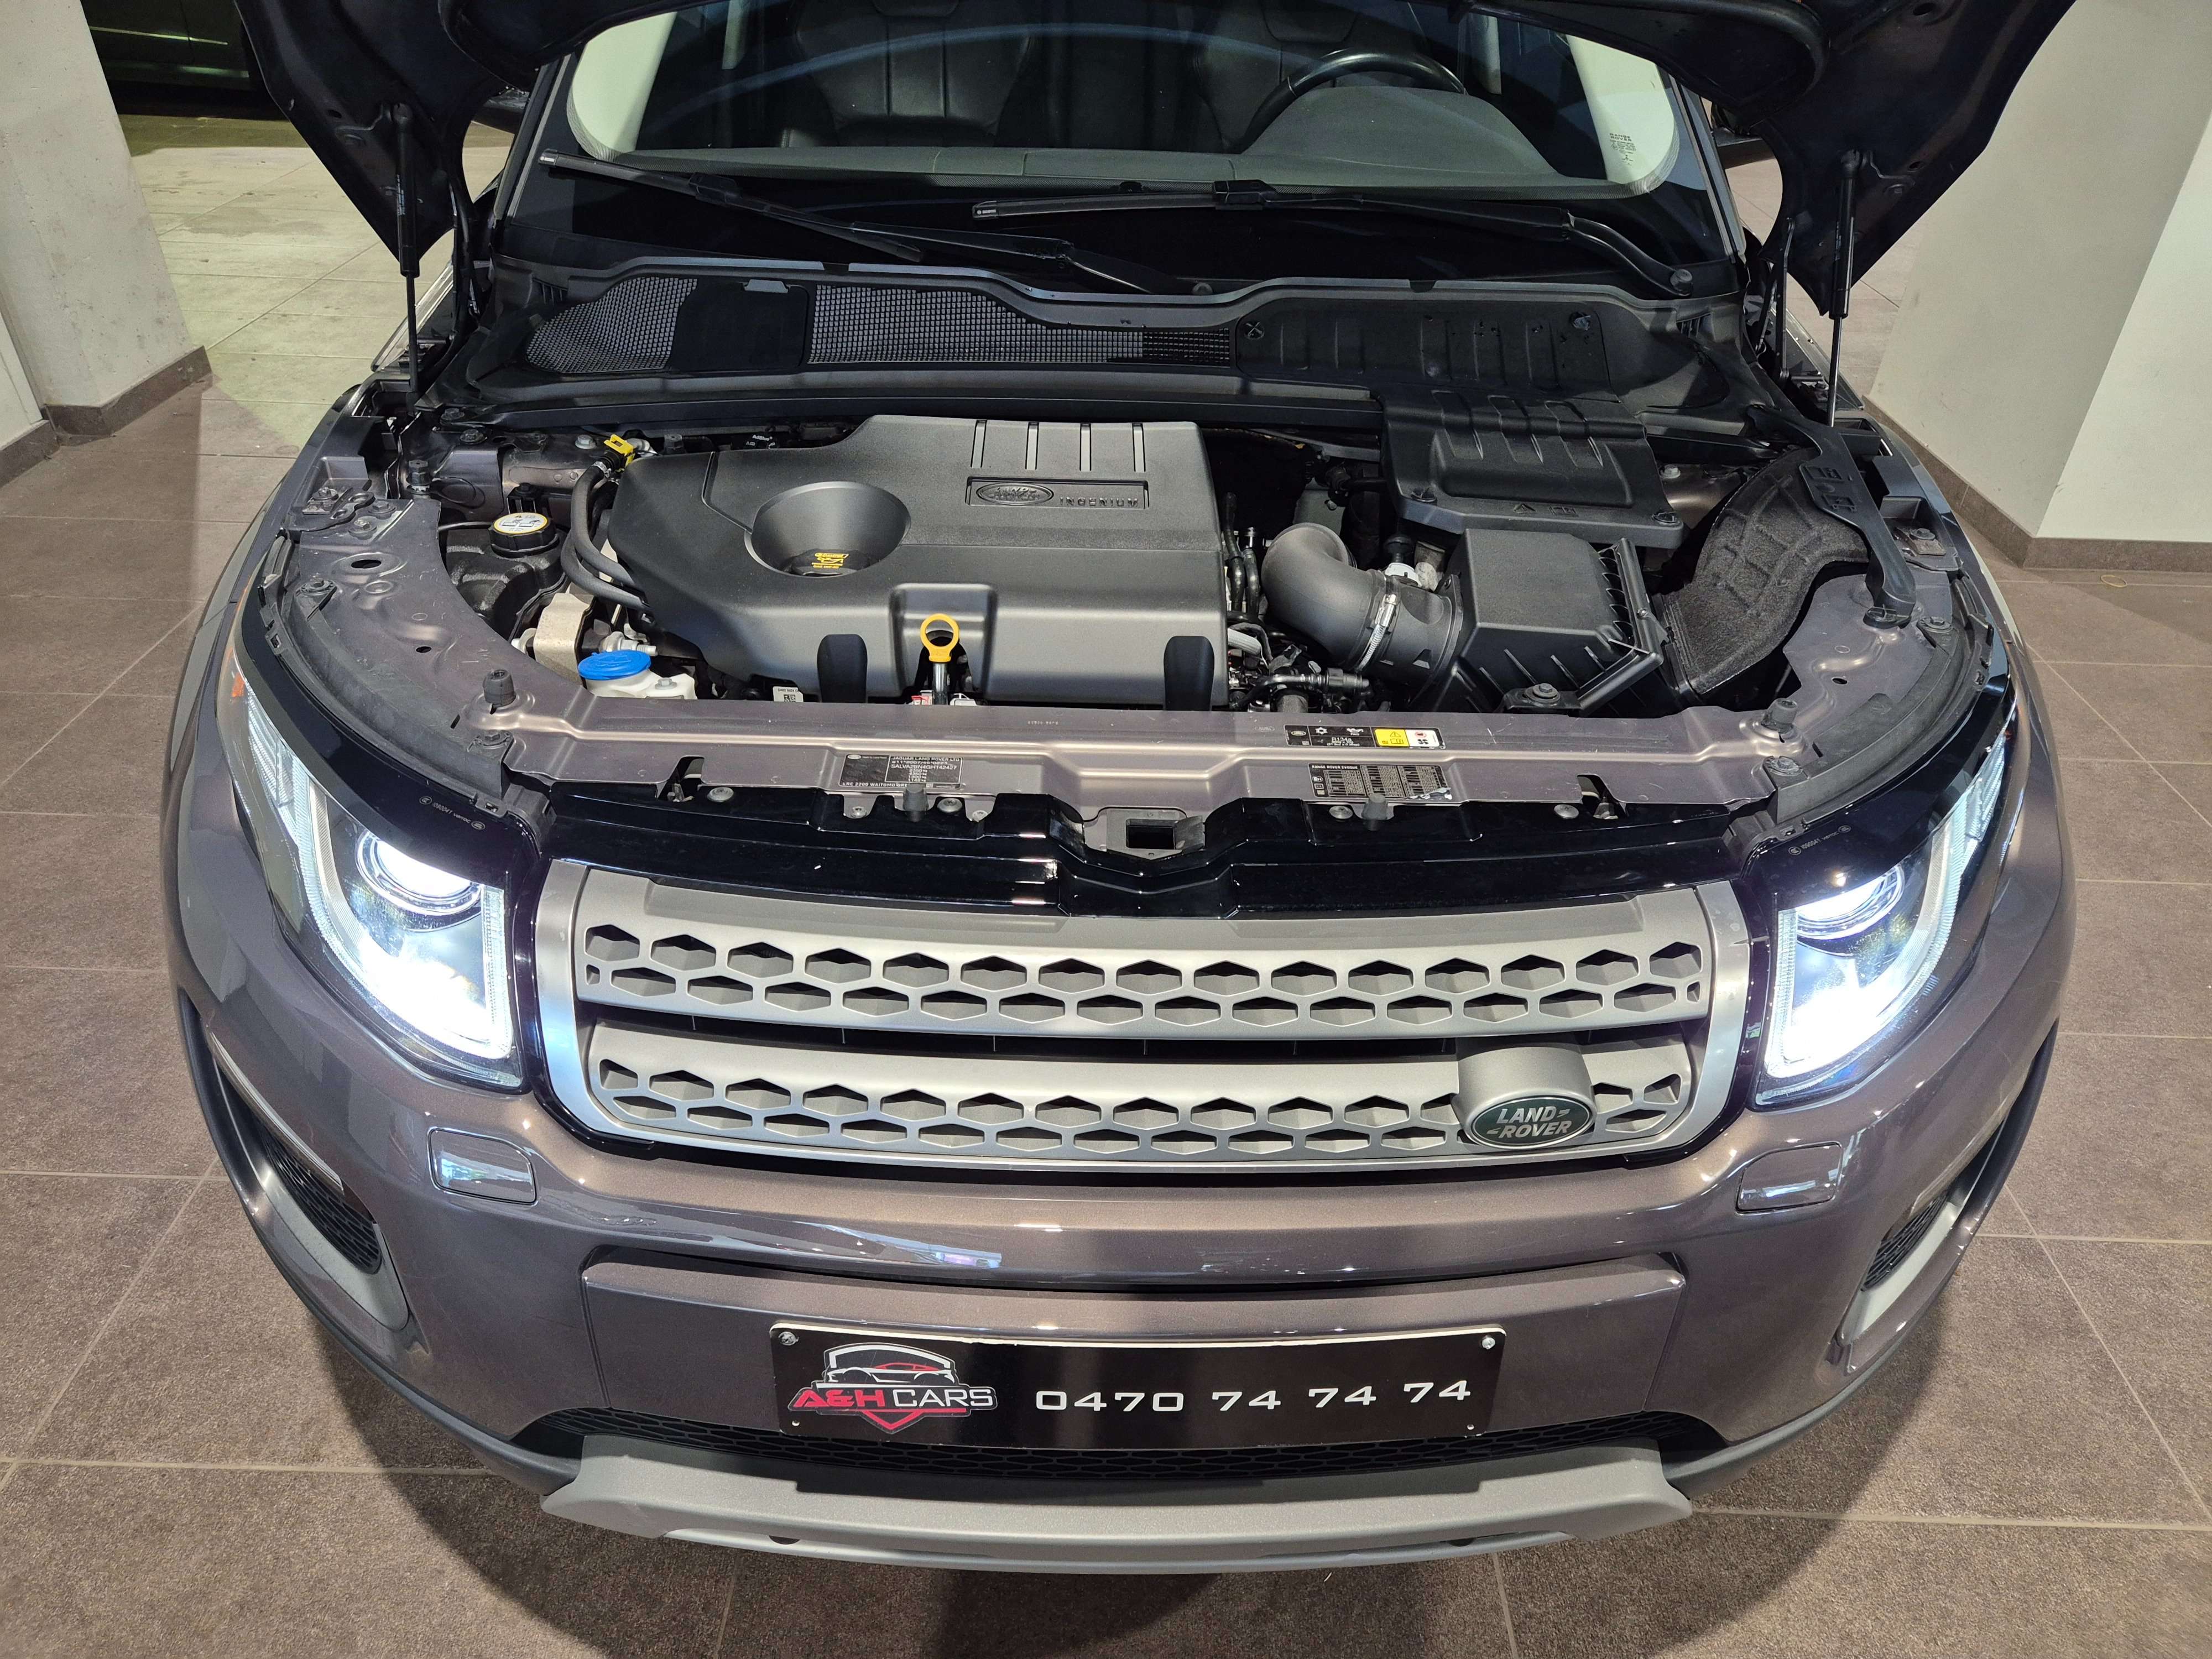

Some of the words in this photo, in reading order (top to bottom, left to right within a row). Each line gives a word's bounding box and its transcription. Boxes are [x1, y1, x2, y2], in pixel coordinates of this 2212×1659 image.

[1060, 497, 1138, 508] INGENIUM
[1496, 1106, 1557, 1124] LAND
[1498, 1120, 1572, 1139] ROVER
[793, 1389, 885, 1407] A&H
[893, 1389, 993, 1407] CARS
[1036, 1390, 1184, 1412] 0470
[1212, 1390, 1282, 1412] 74
[1308, 1386, 1377, 1408] 74
[1403, 1380, 1472, 1403] 74
